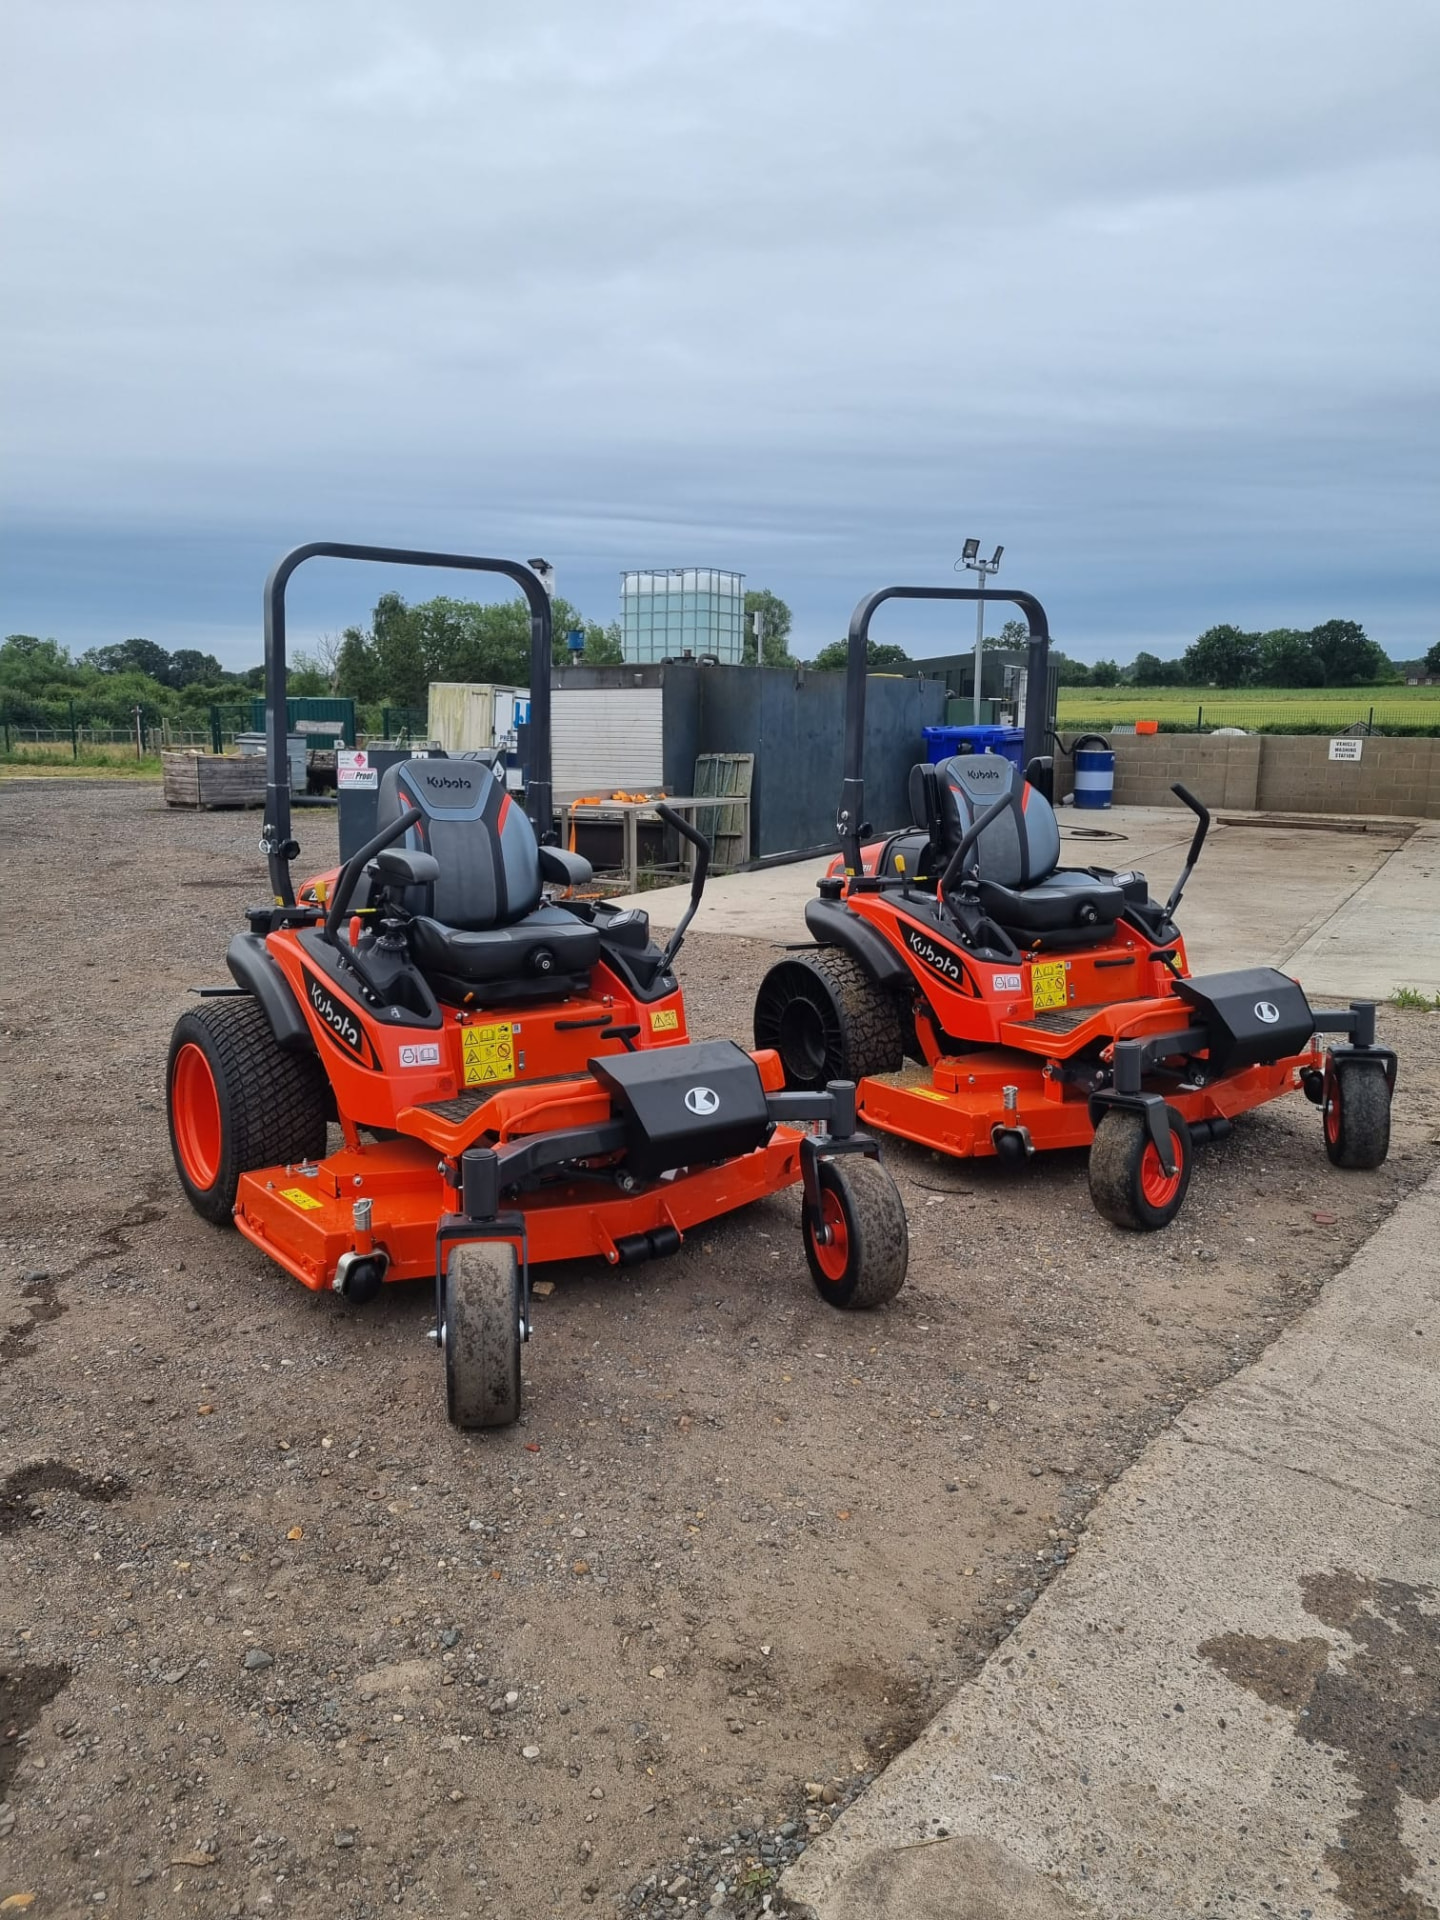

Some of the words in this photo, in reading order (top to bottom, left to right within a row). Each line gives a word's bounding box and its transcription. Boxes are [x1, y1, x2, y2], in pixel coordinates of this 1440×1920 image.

[355, 771, 374, 780] Proof
[967, 769, 1000, 780] Kubota
[426, 776, 472, 789] Kubota
[909, 932, 960, 980] Kubota
[311, 982, 358, 1046] Kubota
